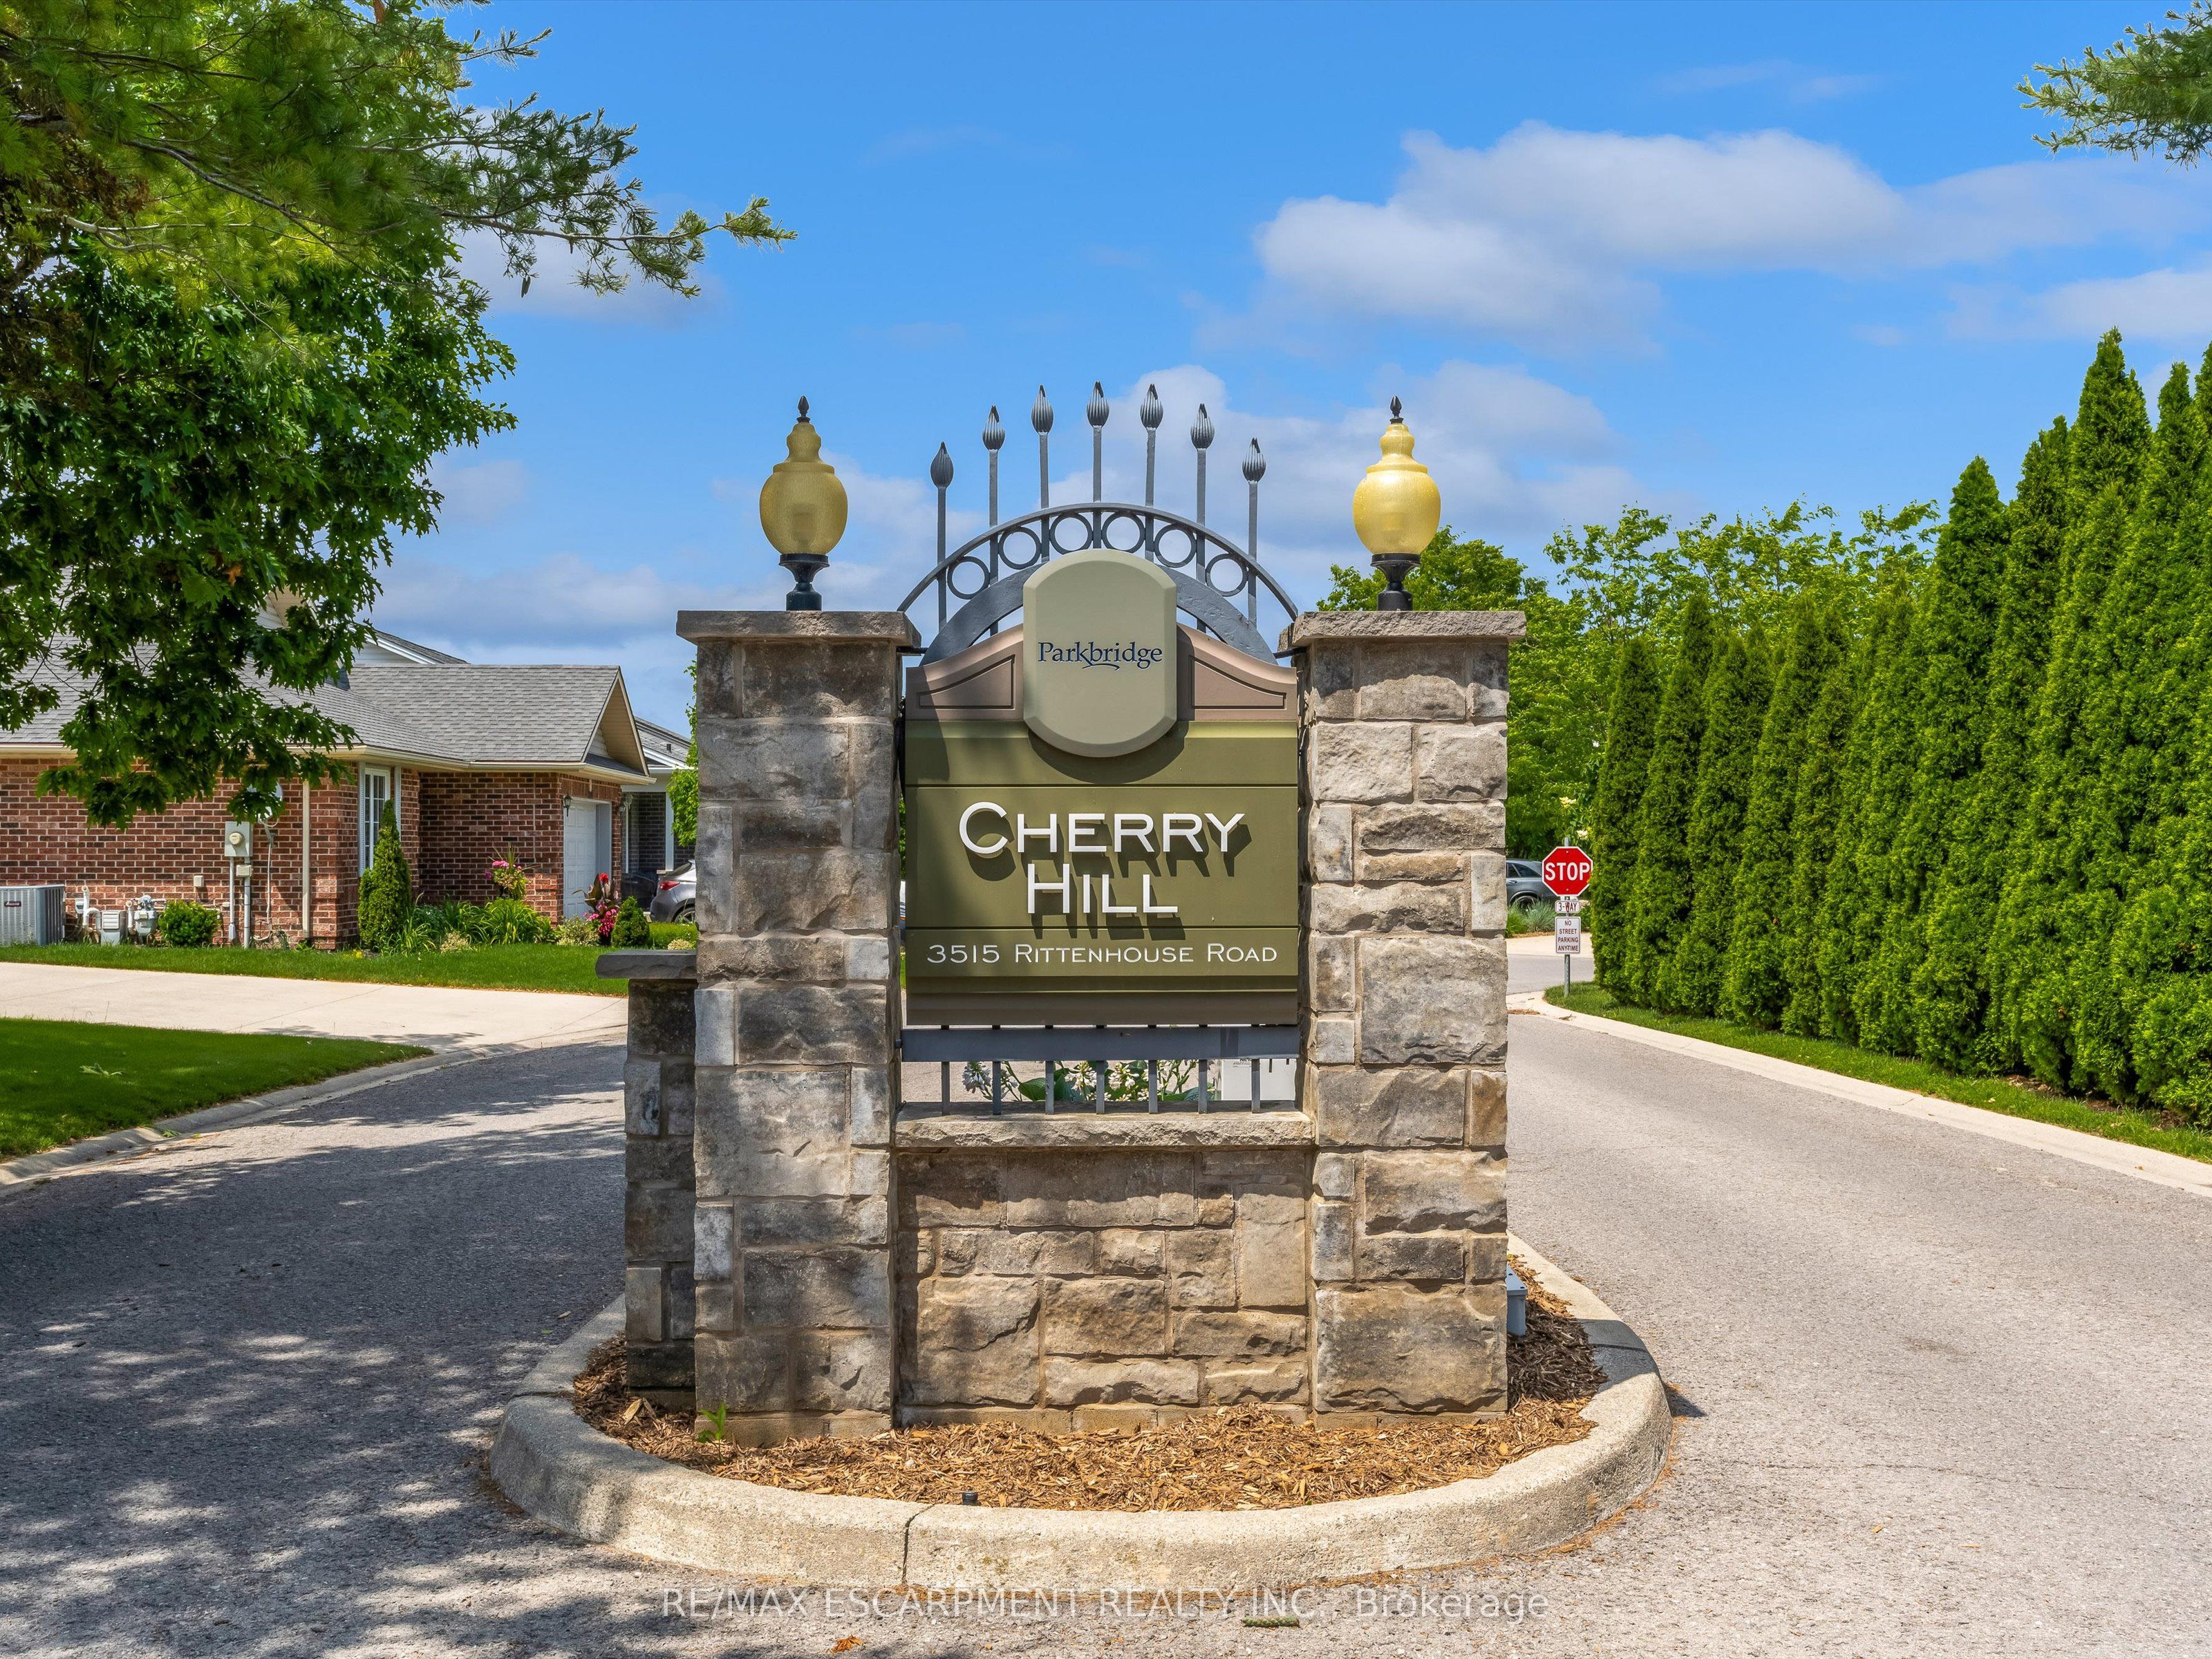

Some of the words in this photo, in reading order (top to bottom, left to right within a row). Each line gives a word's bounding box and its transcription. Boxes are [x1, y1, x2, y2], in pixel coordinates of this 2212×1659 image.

[1038, 641, 1163, 671] Parkbridge
[959, 801, 1246, 854] CHERRY
[1545, 862, 1590, 881] STOP
[1027, 863, 1179, 914] HILL
[1558, 902, 1577, 912] 3-WAY
[926, 944, 1000, 963] 3515
[1015, 944, 1194, 963] RITTENHOUSE
[1207, 943, 1277, 962] ROAD
